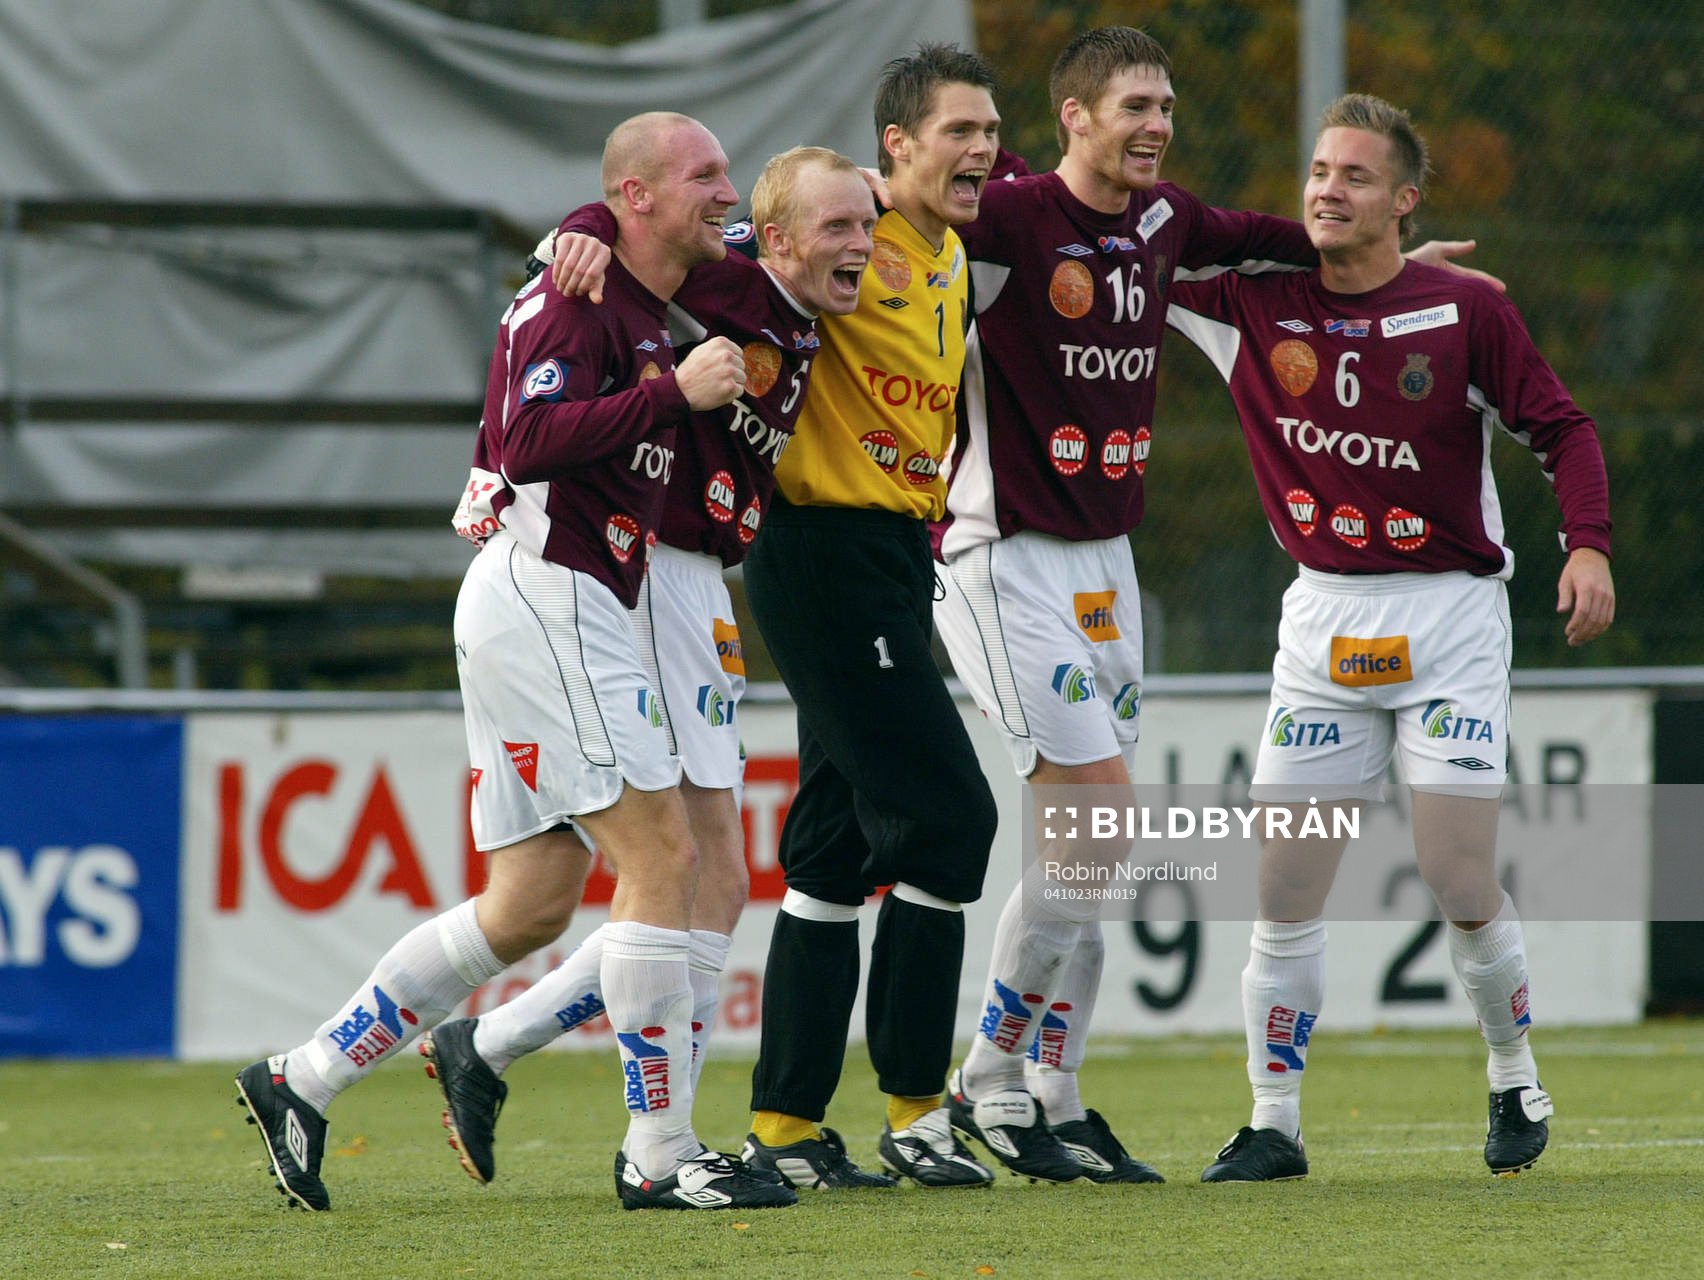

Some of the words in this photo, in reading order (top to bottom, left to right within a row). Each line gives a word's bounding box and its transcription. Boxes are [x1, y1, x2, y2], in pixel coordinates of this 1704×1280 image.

[1105, 263, 1146, 323] 16
[935, 301, 945, 358] 1
[1386, 309, 1446, 334] Spendrups
[1059, 344, 1157, 382] TOYOT
[1335, 351, 1361, 408] 6
[781, 360, 809, 414] 5
[862, 365, 957, 417] TOYO
[729, 399, 790, 465] TOYO
[1052, 438, 1085, 461] OLW
[1275, 416, 1421, 472] TOYOTA
[1103, 444, 1130, 465] OLW
[707, 479, 735, 511] OLW
[1332, 515, 1366, 537] OLW
[1386, 517, 1425, 539] OLW
[873, 636, 894, 669] 1
[1338, 652, 1402, 675] office
[714, 701, 735, 726] SI
[1437, 715, 1494, 744] SITA
[1280, 722, 1341, 747] SITA
[216, 759, 438, 914] ICA
[0, 845, 141, 967] YS
[1129, 859, 1203, 1012] 9
[1266, 1005, 1297, 1045] INTER
[346, 1024, 398, 1068] INTER
[1041, 1029, 1068, 1067] INTER
[623, 1059, 650, 1113] SPORT
[641, 1057, 671, 1112] INTER
